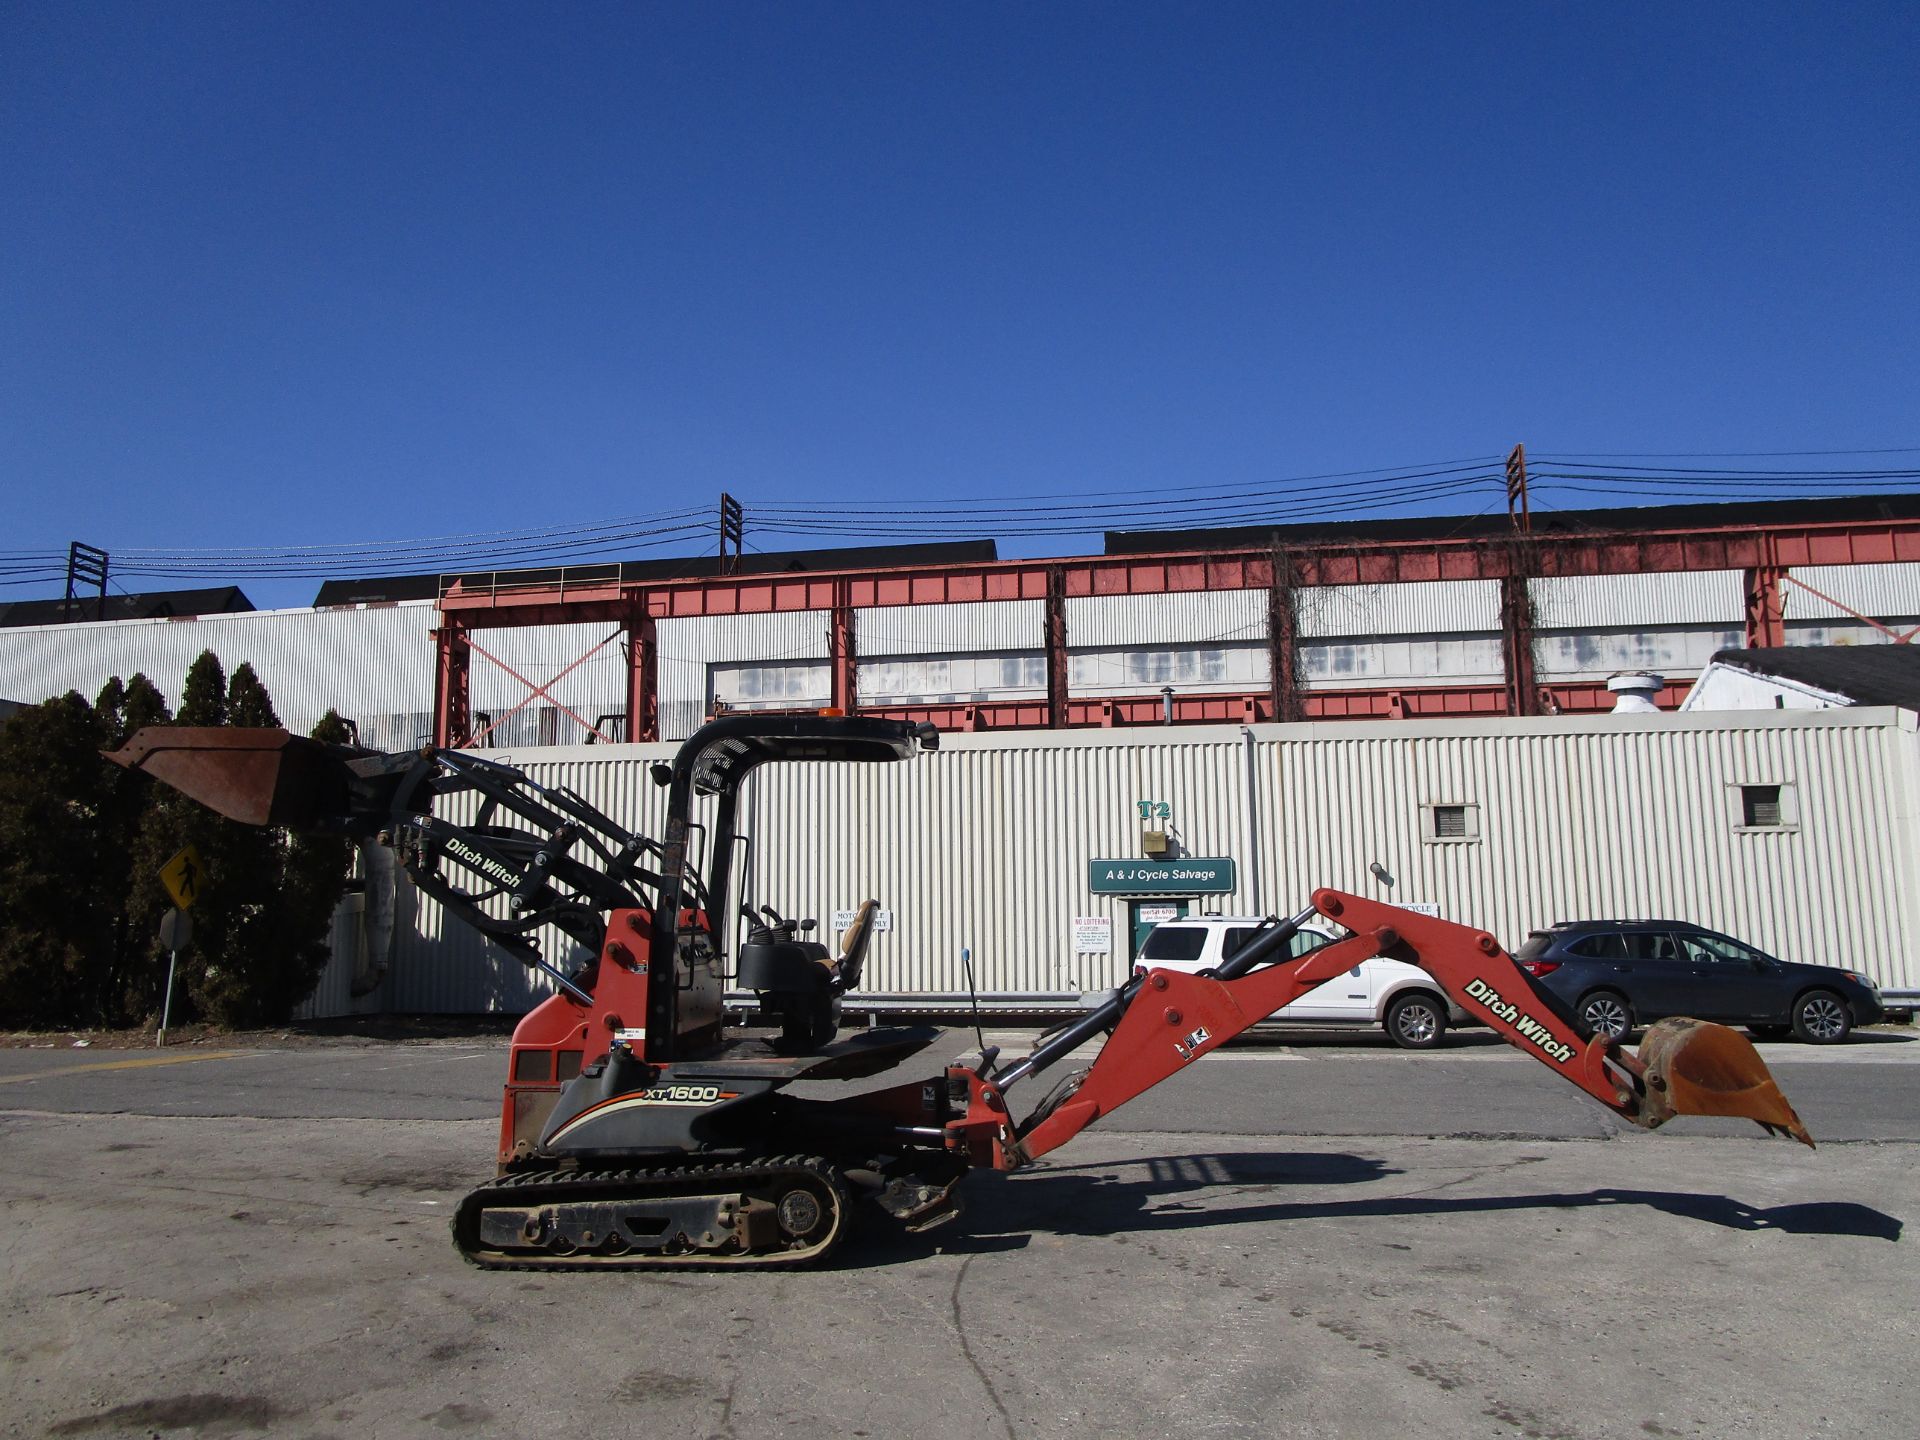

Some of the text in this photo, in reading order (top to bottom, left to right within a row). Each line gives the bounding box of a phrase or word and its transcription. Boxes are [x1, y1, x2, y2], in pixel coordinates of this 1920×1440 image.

[1137, 800, 1171, 819] T2
[445, 837, 521, 888] Ditch Witch
[1106, 869, 1216, 882] A & J Cycle Salvage
[1464, 979, 1571, 1062] Ditch Witch
